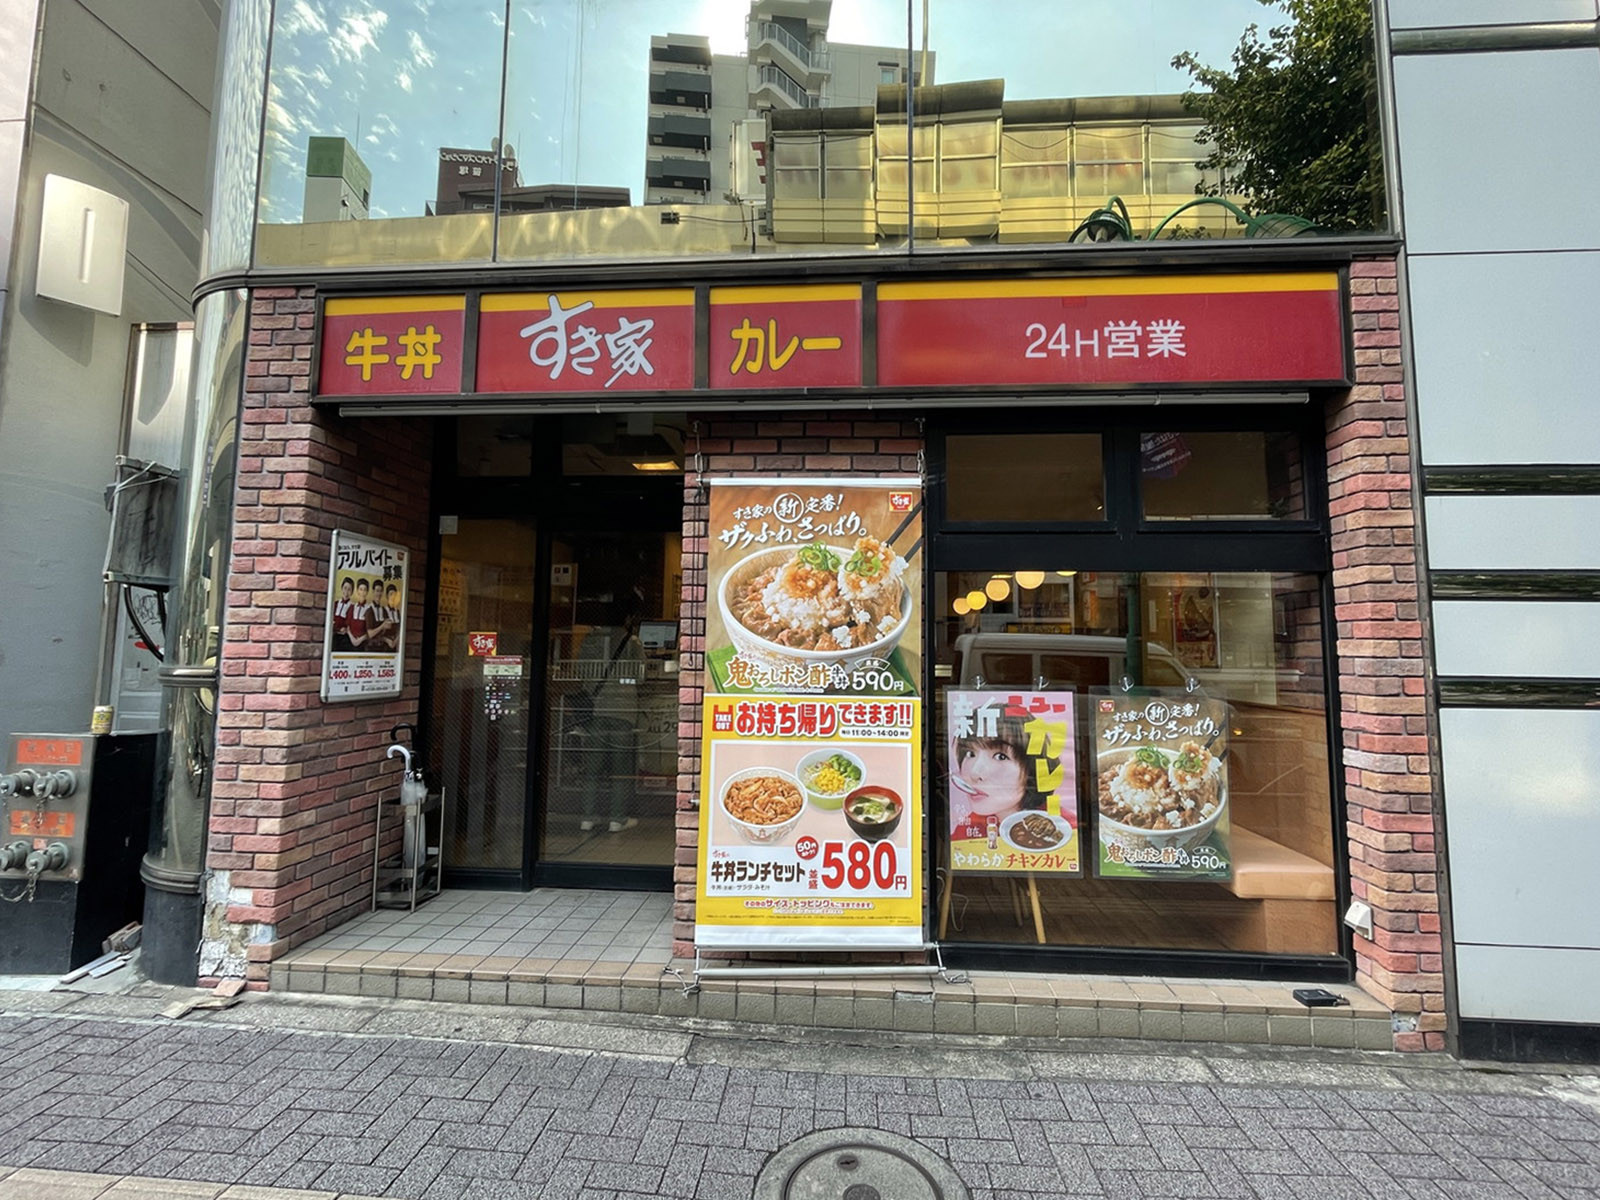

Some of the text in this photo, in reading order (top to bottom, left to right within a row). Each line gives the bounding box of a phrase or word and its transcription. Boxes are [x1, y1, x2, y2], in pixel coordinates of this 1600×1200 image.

[345, 325, 442, 382] 牛丼
[520, 294, 655, 388] すき家
[730, 318, 842, 374] カレー
[1025, 319, 1187, 359] 24H営業
[718, 511, 867, 549] ザクふわ、さっぱり。
[337, 549, 392, 570] アルバイト
[383, 565, 402, 581] 募集
[852, 671, 904, 692] 590円
[953, 694, 1000, 739] 新
[1005, 695, 1067, 717] ニュー
[1102, 717, 1220, 746] ザクふわ、さっぱり。
[1024, 718, 1068, 816] カレー
[711, 861, 806, 883] 牛丼ランチセット
[821, 841, 908, 890] 580円
